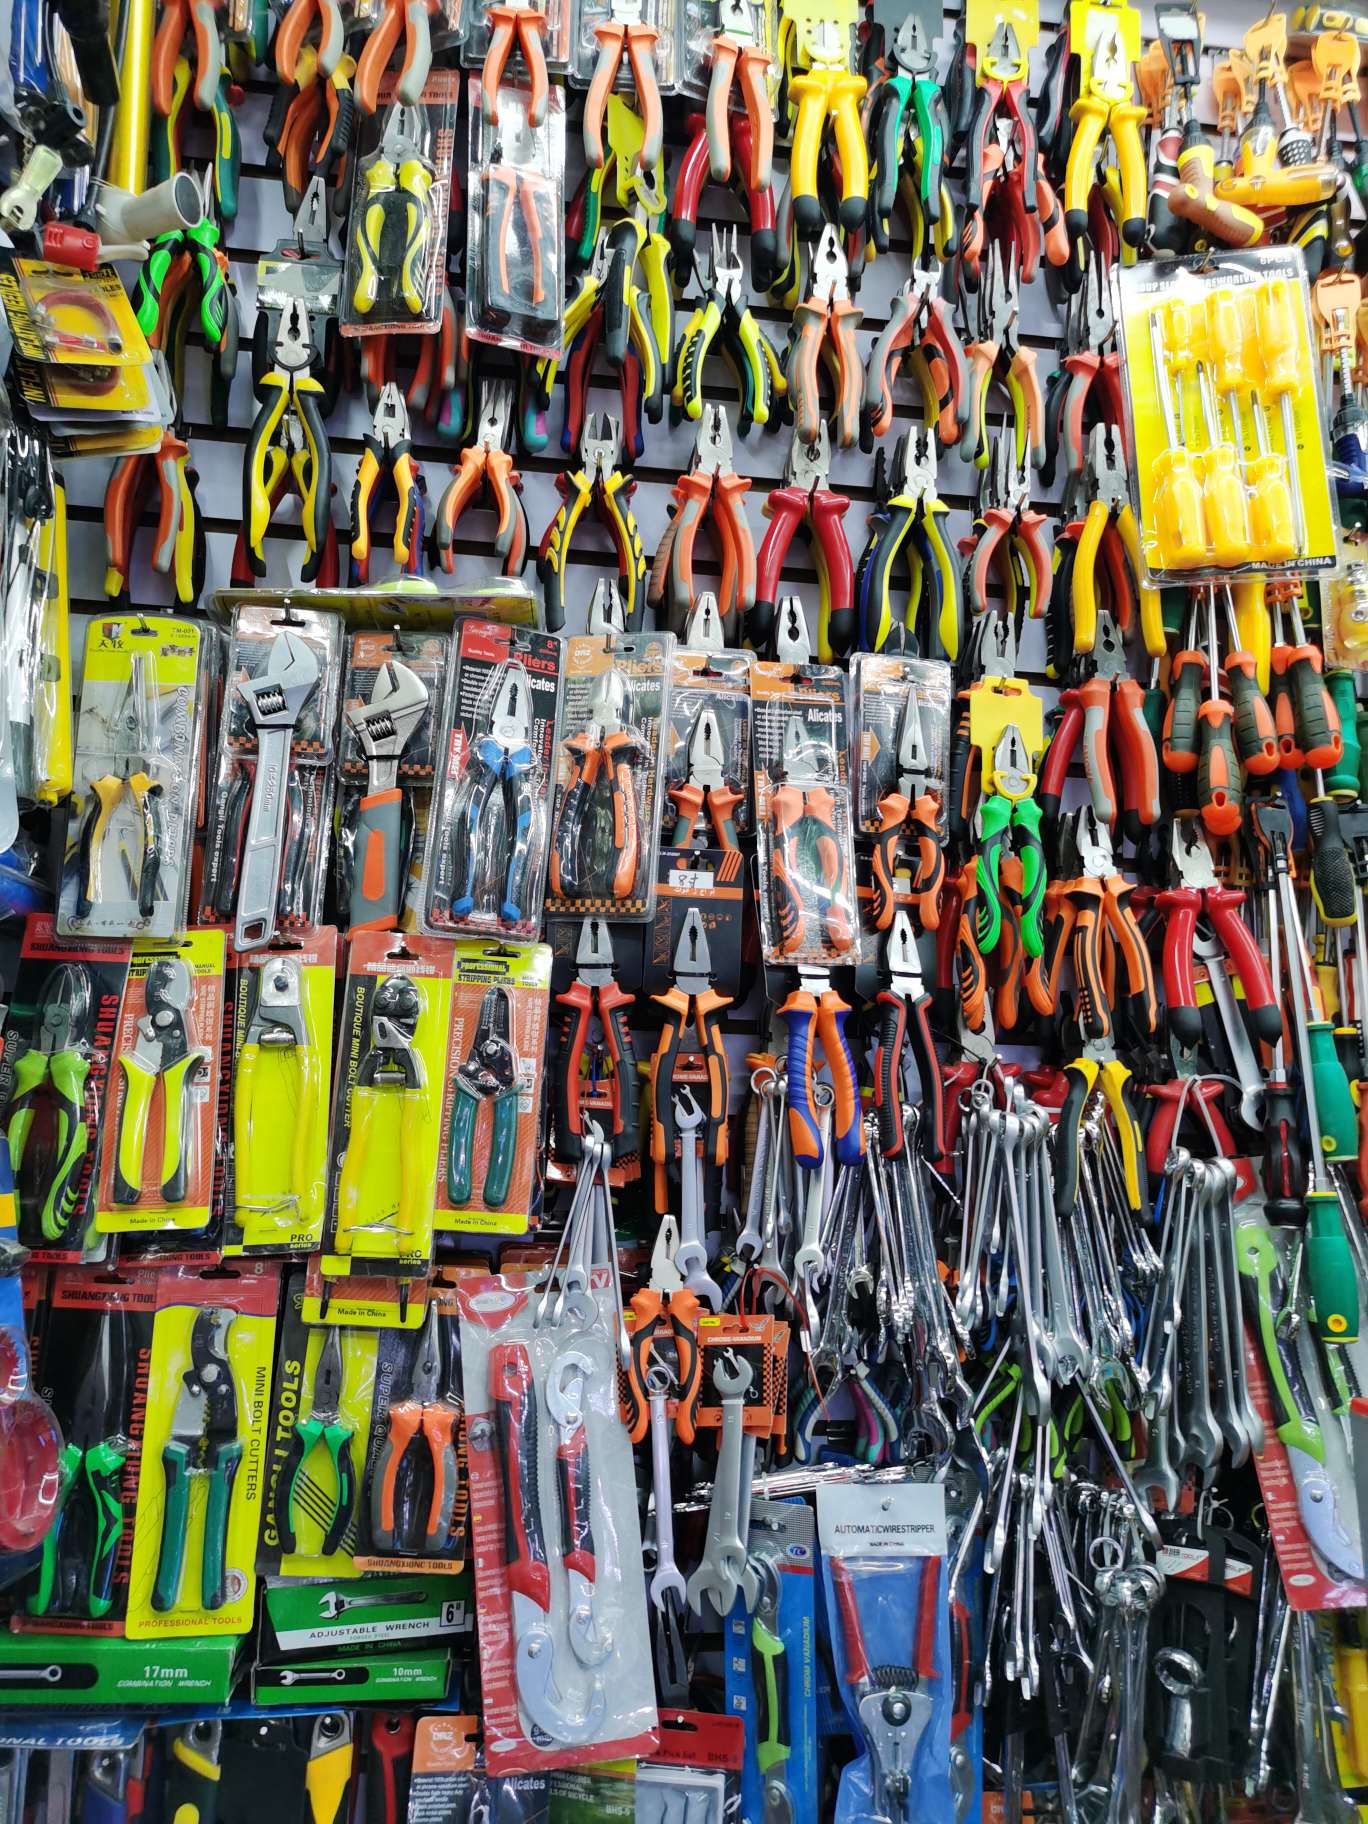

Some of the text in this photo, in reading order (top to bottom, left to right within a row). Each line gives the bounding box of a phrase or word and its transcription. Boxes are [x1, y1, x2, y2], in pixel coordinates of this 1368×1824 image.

[1297, 557, 1332, 567] CHINA
[526, 674, 556, 693] licates
[807, 708, 842, 723] Alicates
[215, 823, 227, 849] Tools
[210, 851, 221, 882] expert
[237, 978, 248, 1030] BOUTIQUE
[352, 986, 366, 1037] BOUTIQUE
[350, 1038, 361, 1059] MINI
[290, 1234, 313, 1242] PRO
[254, 1262, 264, 1274] 8
[132, 1293, 157, 1304] TOOL
[337, 1307, 357, 1315] Made
[366, 1309, 387, 1318] China
[276, 1359, 301, 1442] TOOLS
[246, 1366, 267, 1501] MINI BOLT CUTTERS
[834, 1524, 936, 1534] AUTOMATICWIRESTRIPPER
[445, 1602, 462, 1623] 6"
[139, 1616, 243, 1629] PROFESSIONAL TOOLS
[309, 1621, 430, 1639] ADJUSTABLE WRENCH
[143, 1666, 188, 1678] 17mm
[393, 1667, 423, 1676] 10mm
[178, 1679, 212, 1687] WRENCH
[503, 1778, 546, 1790] Alicates
